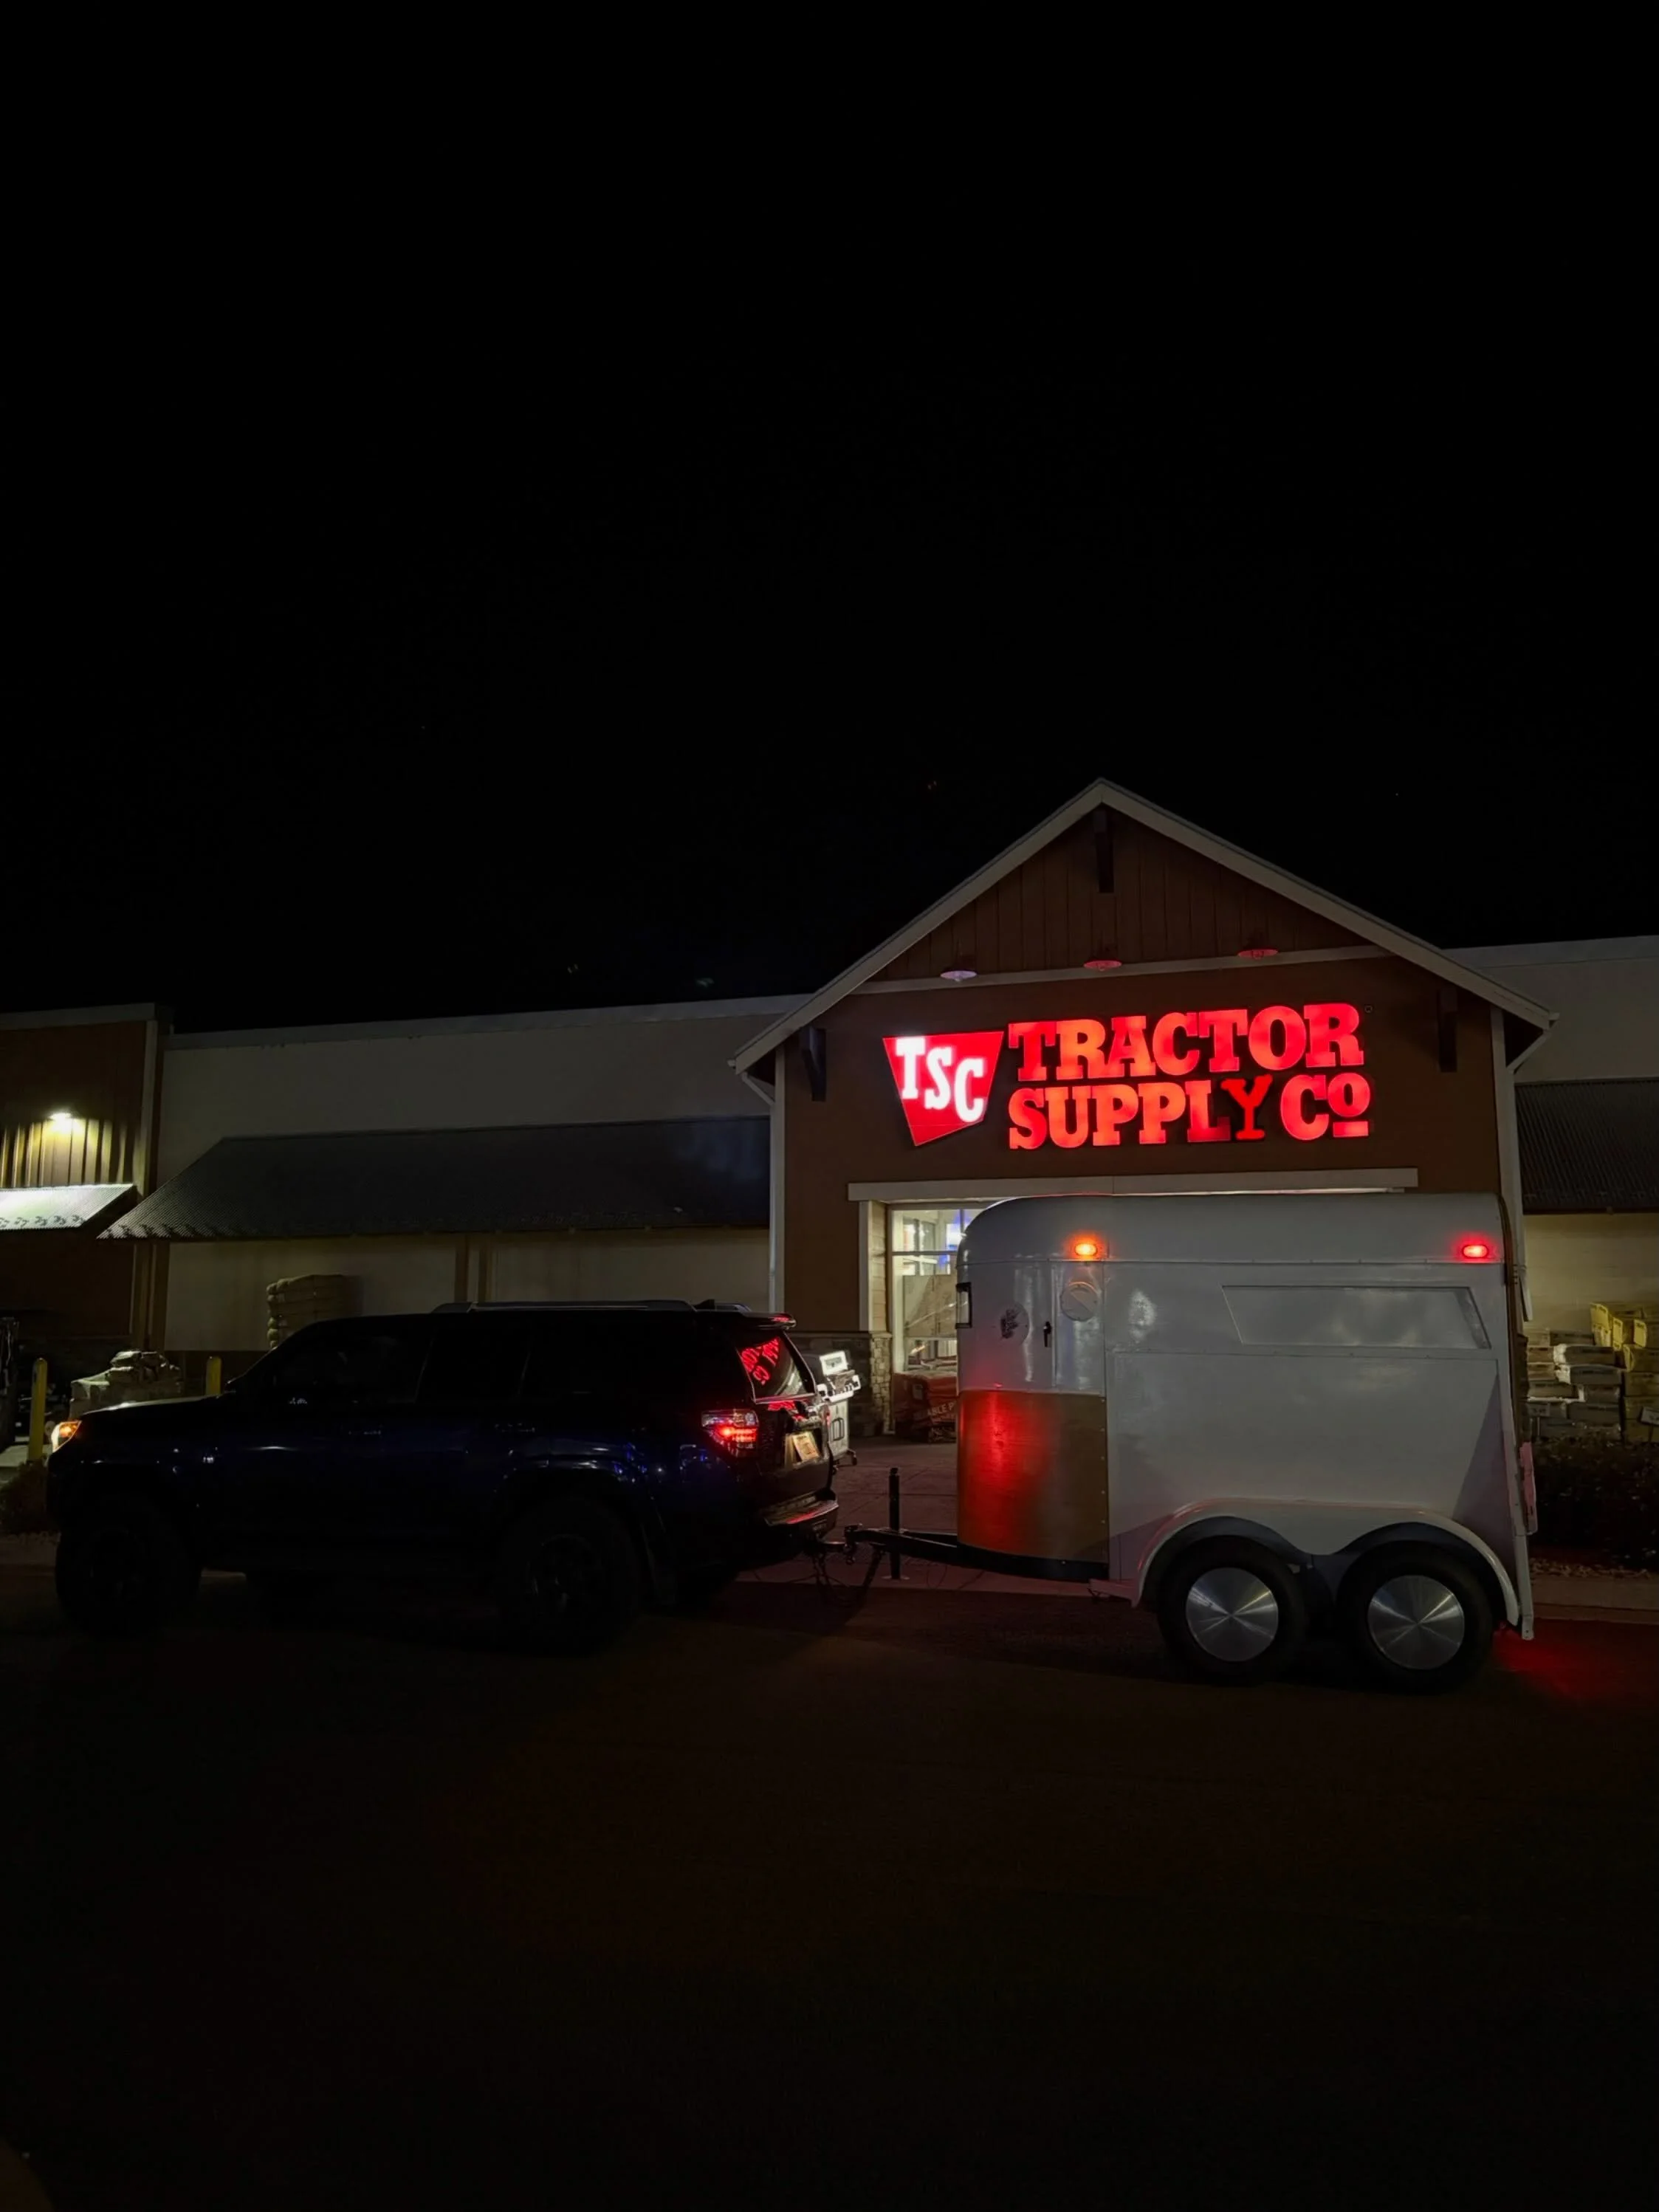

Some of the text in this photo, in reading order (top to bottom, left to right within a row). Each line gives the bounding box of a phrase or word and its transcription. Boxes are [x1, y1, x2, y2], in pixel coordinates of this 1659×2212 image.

[895, 1036, 985, 1123] TSC
[1008, 1003, 1364, 1082] TRACTOR
[1008, 1074, 1273, 1150] SUPPLY
